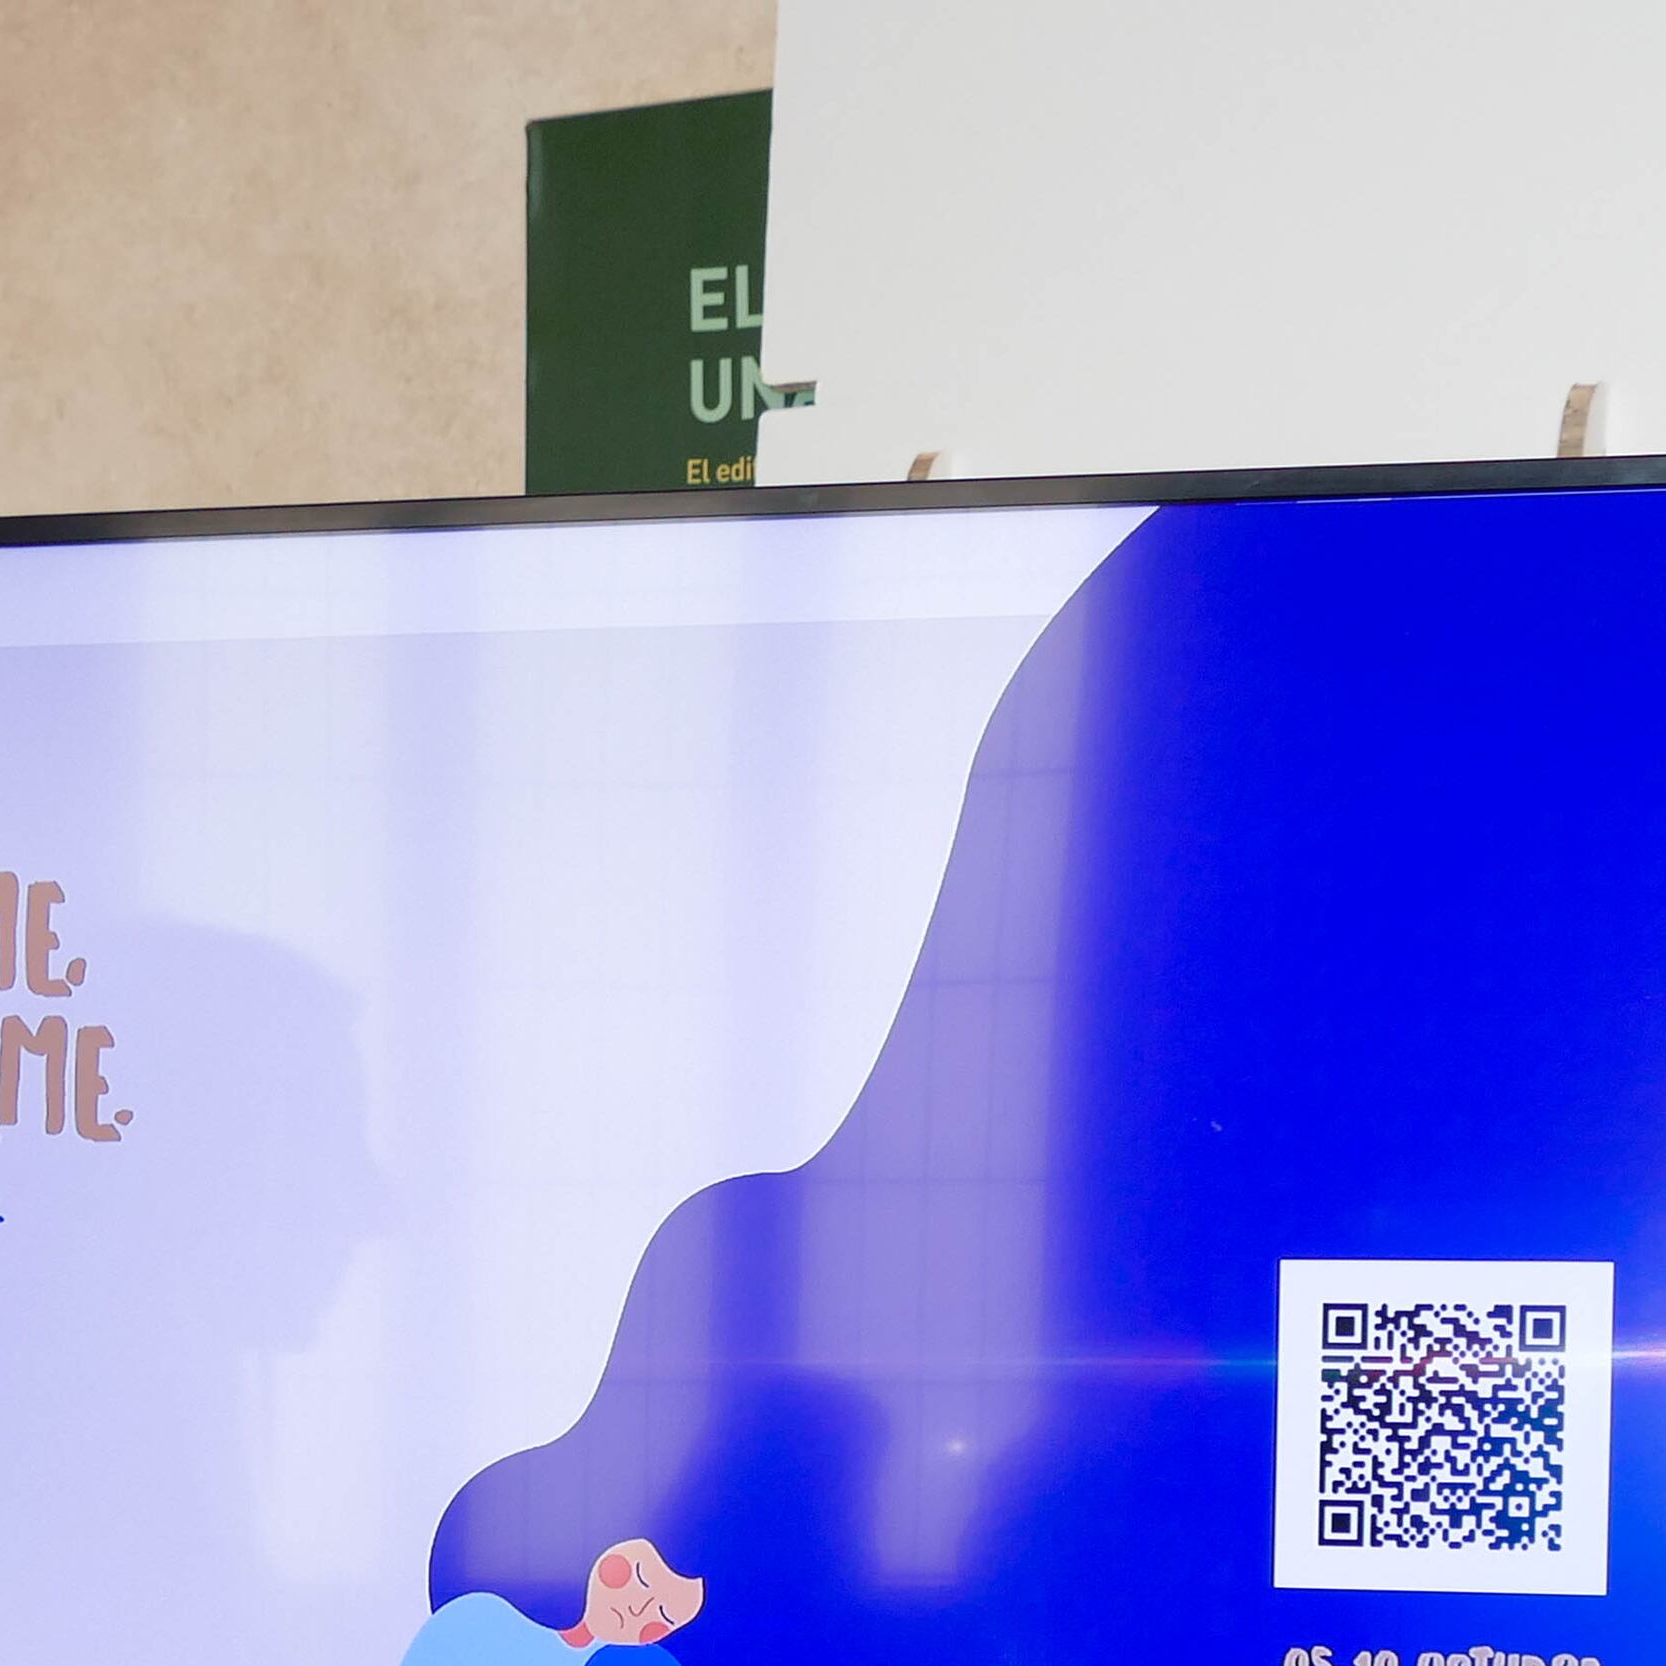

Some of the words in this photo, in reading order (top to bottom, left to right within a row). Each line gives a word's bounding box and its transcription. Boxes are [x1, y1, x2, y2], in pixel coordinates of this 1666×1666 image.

[689, 264, 764, 333] EL
[689, 355, 817, 424] UN
[686, 459, 710, 485] El
